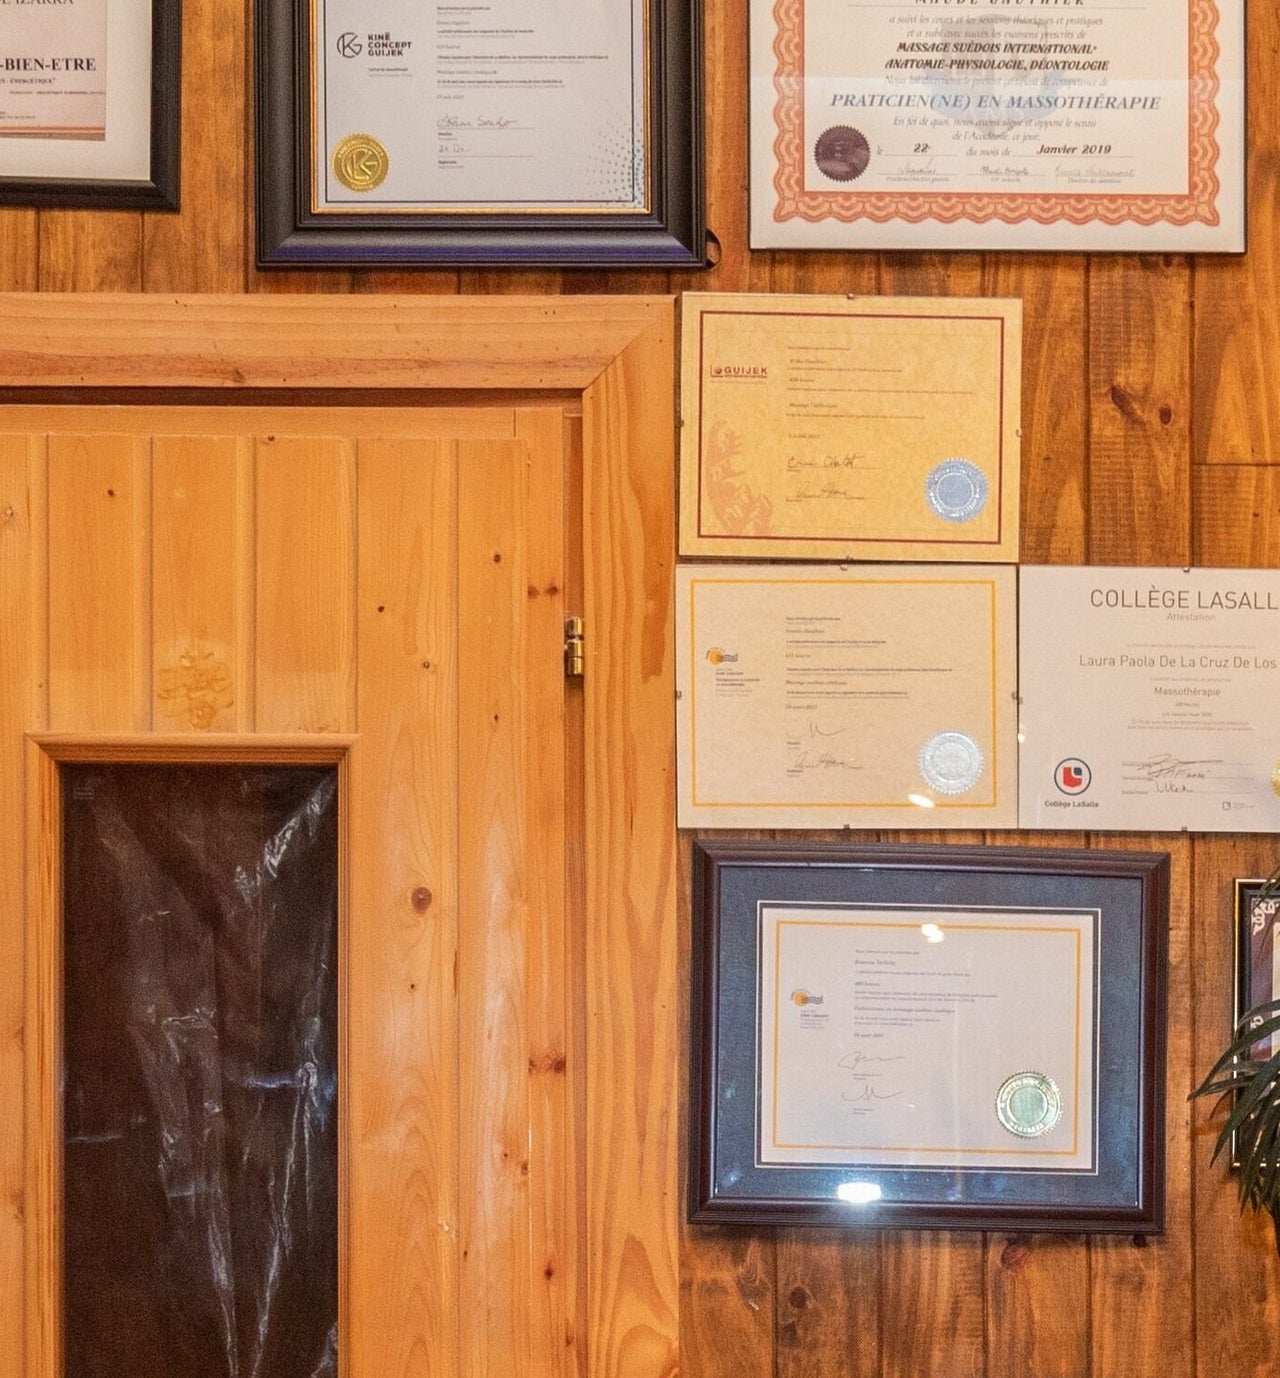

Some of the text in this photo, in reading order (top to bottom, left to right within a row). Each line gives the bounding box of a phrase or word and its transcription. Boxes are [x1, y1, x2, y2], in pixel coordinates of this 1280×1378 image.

[896, 42, 951, 52] MASSAGE
[952, 39, 1001, 53] SUÉDOIS
[1029, 58, 1110, 71] DÉONTOLOGIE
[831, 93, 970, 110] PRATICIEN(NE)
[978, 95, 1001, 108] EN
[1082, 145, 1112, 155] 2019
[724, 366, 767, 375] GUIJEK
[1090, 584, 1190, 609] COLLÈGE
[1167, 612, 1216, 622] Attestation
[1079, 654, 1116, 667] Laura
[1120, 654, 1155, 668] Paola
[1159, 655, 1177, 668] De
[1180, 655, 1196, 668] La
[1200, 655, 1229, 669] Cruz
[1233, 656, 1250, 669] De
[1254, 657, 1277, 670] Los
[1154, 687, 1221, 697] Massothérapie
